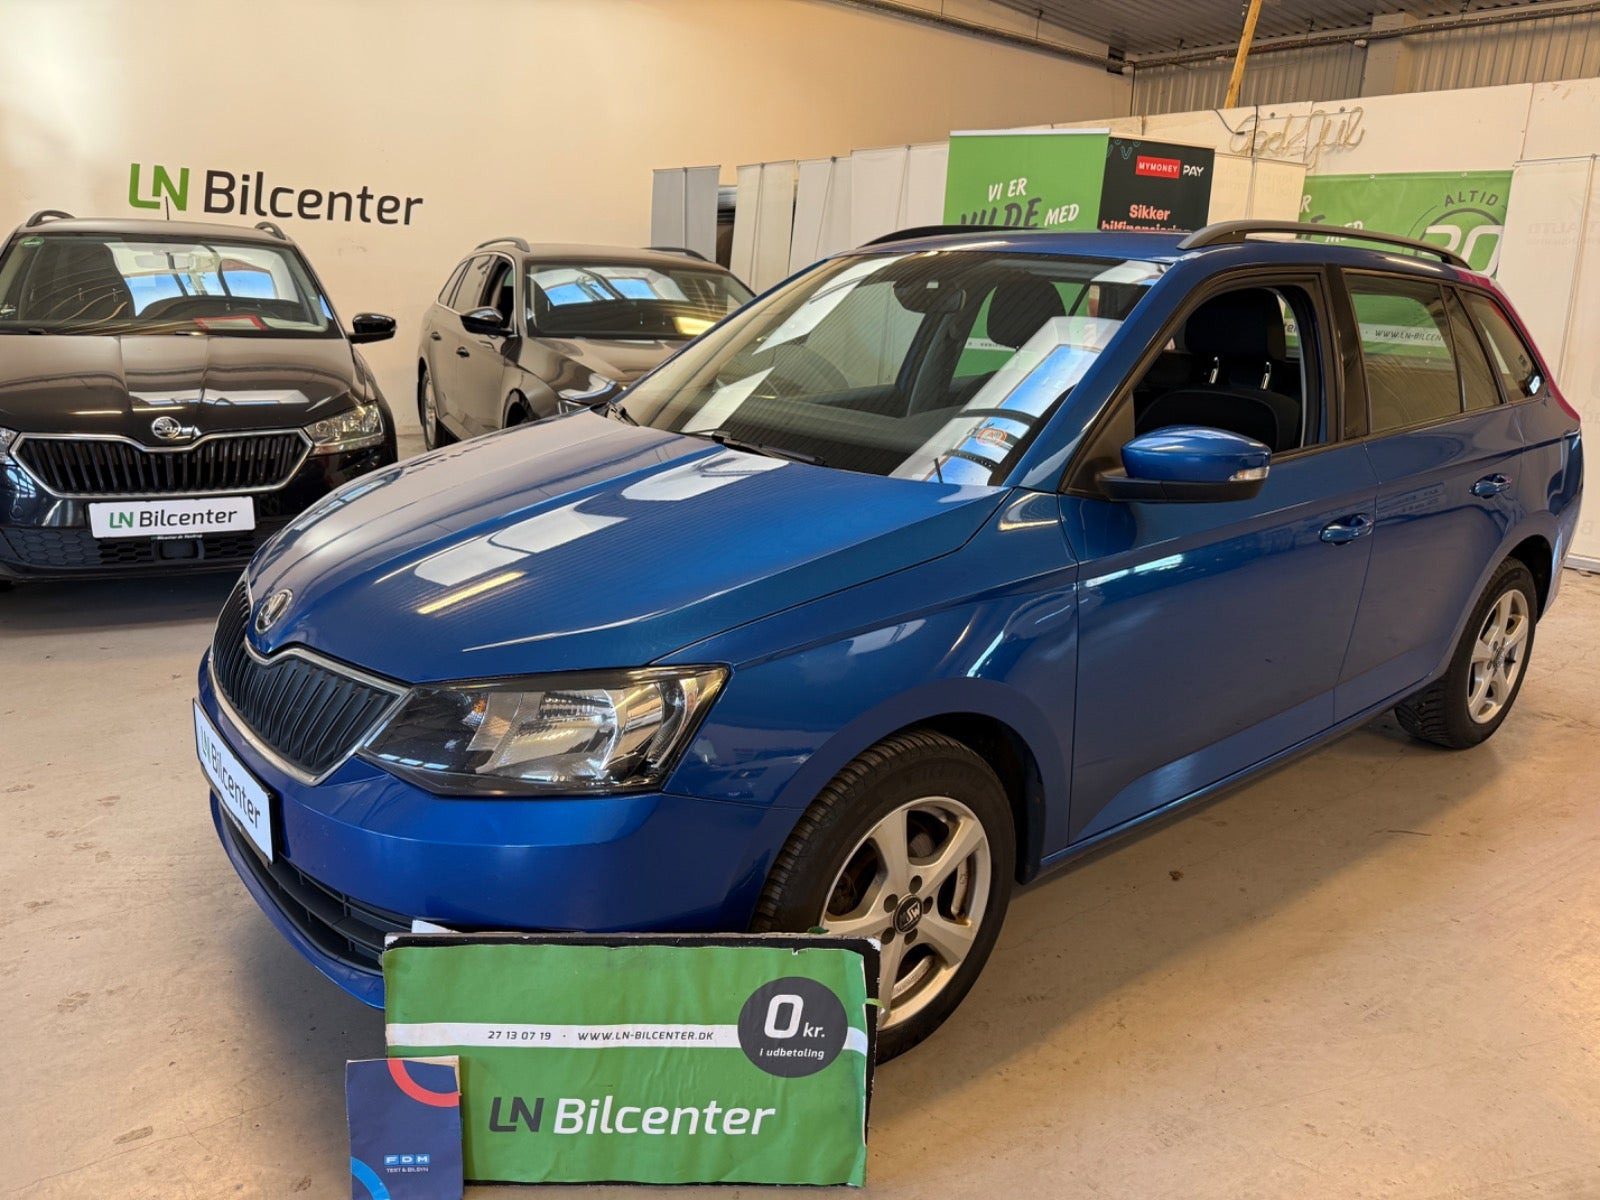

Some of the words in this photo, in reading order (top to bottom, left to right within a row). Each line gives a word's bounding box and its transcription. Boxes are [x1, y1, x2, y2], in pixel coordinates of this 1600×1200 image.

[1139, 161, 1178, 173] MYMONEY
[1182, 164, 1205, 177] PAY
[128, 163, 189, 211] LN
[203, 169, 424, 226] Bilcenter
[988, 183, 1003, 202] VI
[1007, 178, 1027, 198] ER
[1445, 190, 1499, 208] ALTID
[1044, 203, 1080, 227] MED
[1128, 204, 1171, 221] Sikker
[109, 511, 134, 529] LN
[139, 509, 238, 528] Bilcenter
[211, 742, 261, 829] Bilcenter
[764, 994, 804, 1039] 0
[803, 1022, 825, 1038] kr.
[488, 1030, 501, 1040] 27
[506, 1031, 517, 1040] 13
[521, 1031, 535, 1041] 07
[540, 1032, 551, 1041] 19
[577, 1031, 714, 1041] WWW.LN-BILCENTER.DK
[766, 1048, 825, 1060] udbetaling
[489, 1097, 545, 1132] LN
[553, 1095, 776, 1135] Bilcenter
[386, 1155, 428, 1164] FDM
